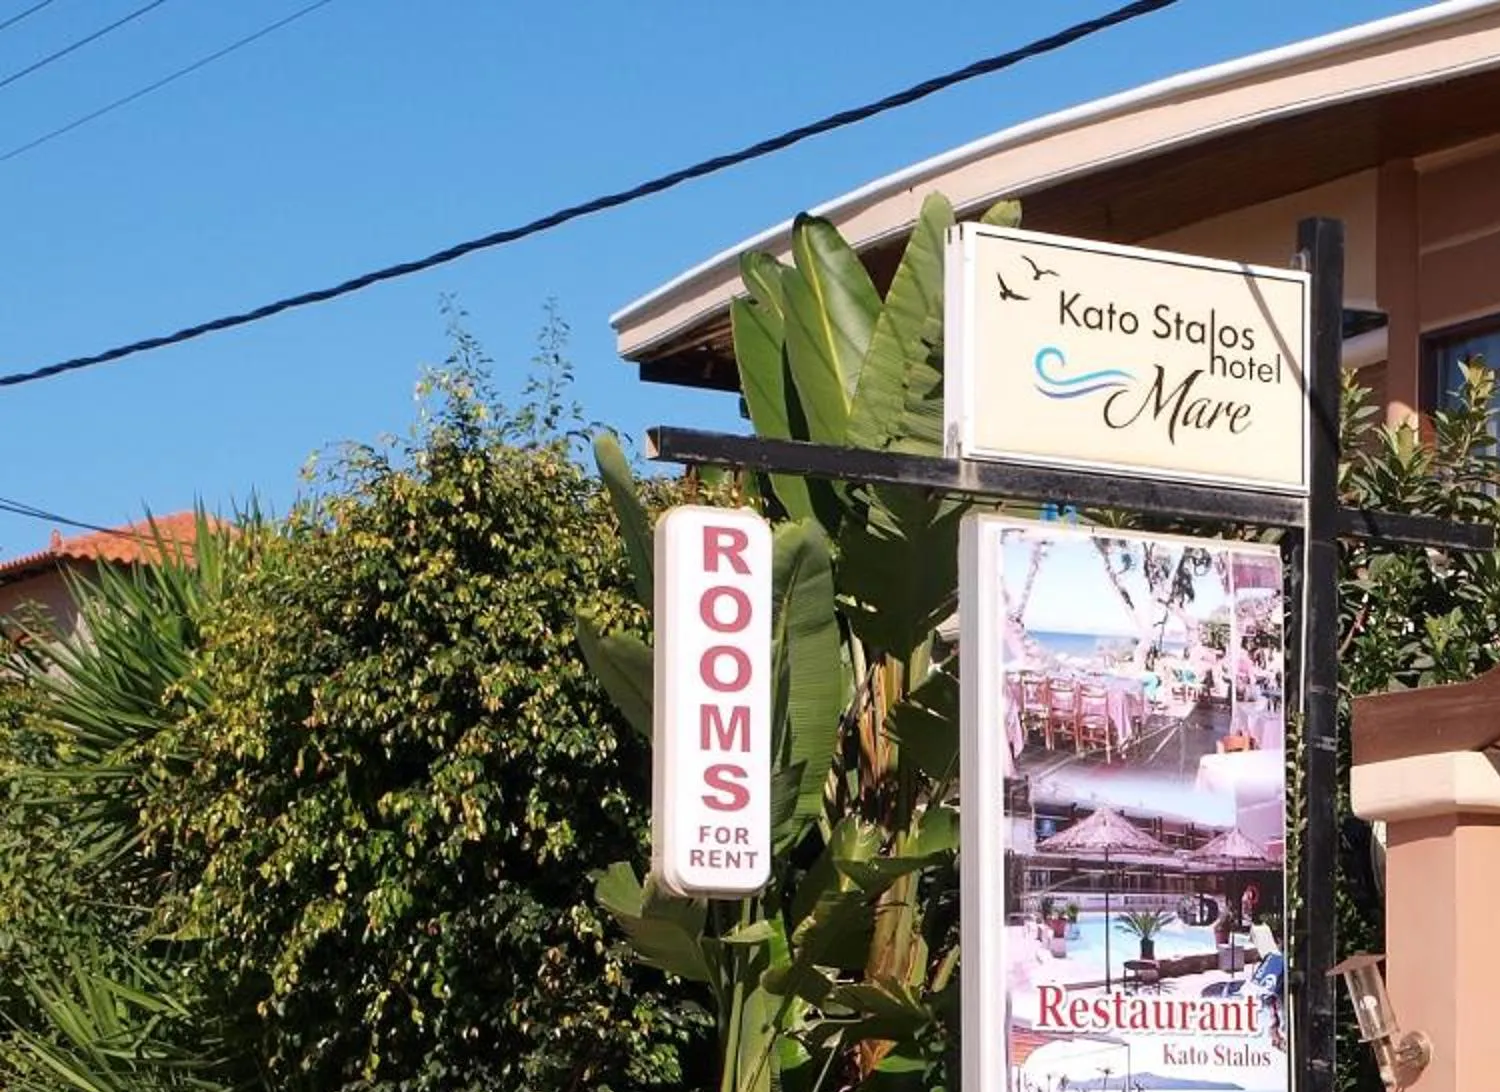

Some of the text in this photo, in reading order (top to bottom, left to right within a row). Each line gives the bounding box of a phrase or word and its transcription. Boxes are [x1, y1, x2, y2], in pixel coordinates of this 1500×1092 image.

[1059, 290, 1255, 352] Kato Stalos
[1209, 352, 1282, 385] hotel
[1103, 364, 1254, 446] Mare
[699, 525, 753, 813] ROOMS
[699, 825, 750, 846] FOR
[689, 849, 759, 869] RENT
[1037, 984, 1261, 1032] Restaurant
[1163, 1043, 1272, 1067] Kato Stalos
